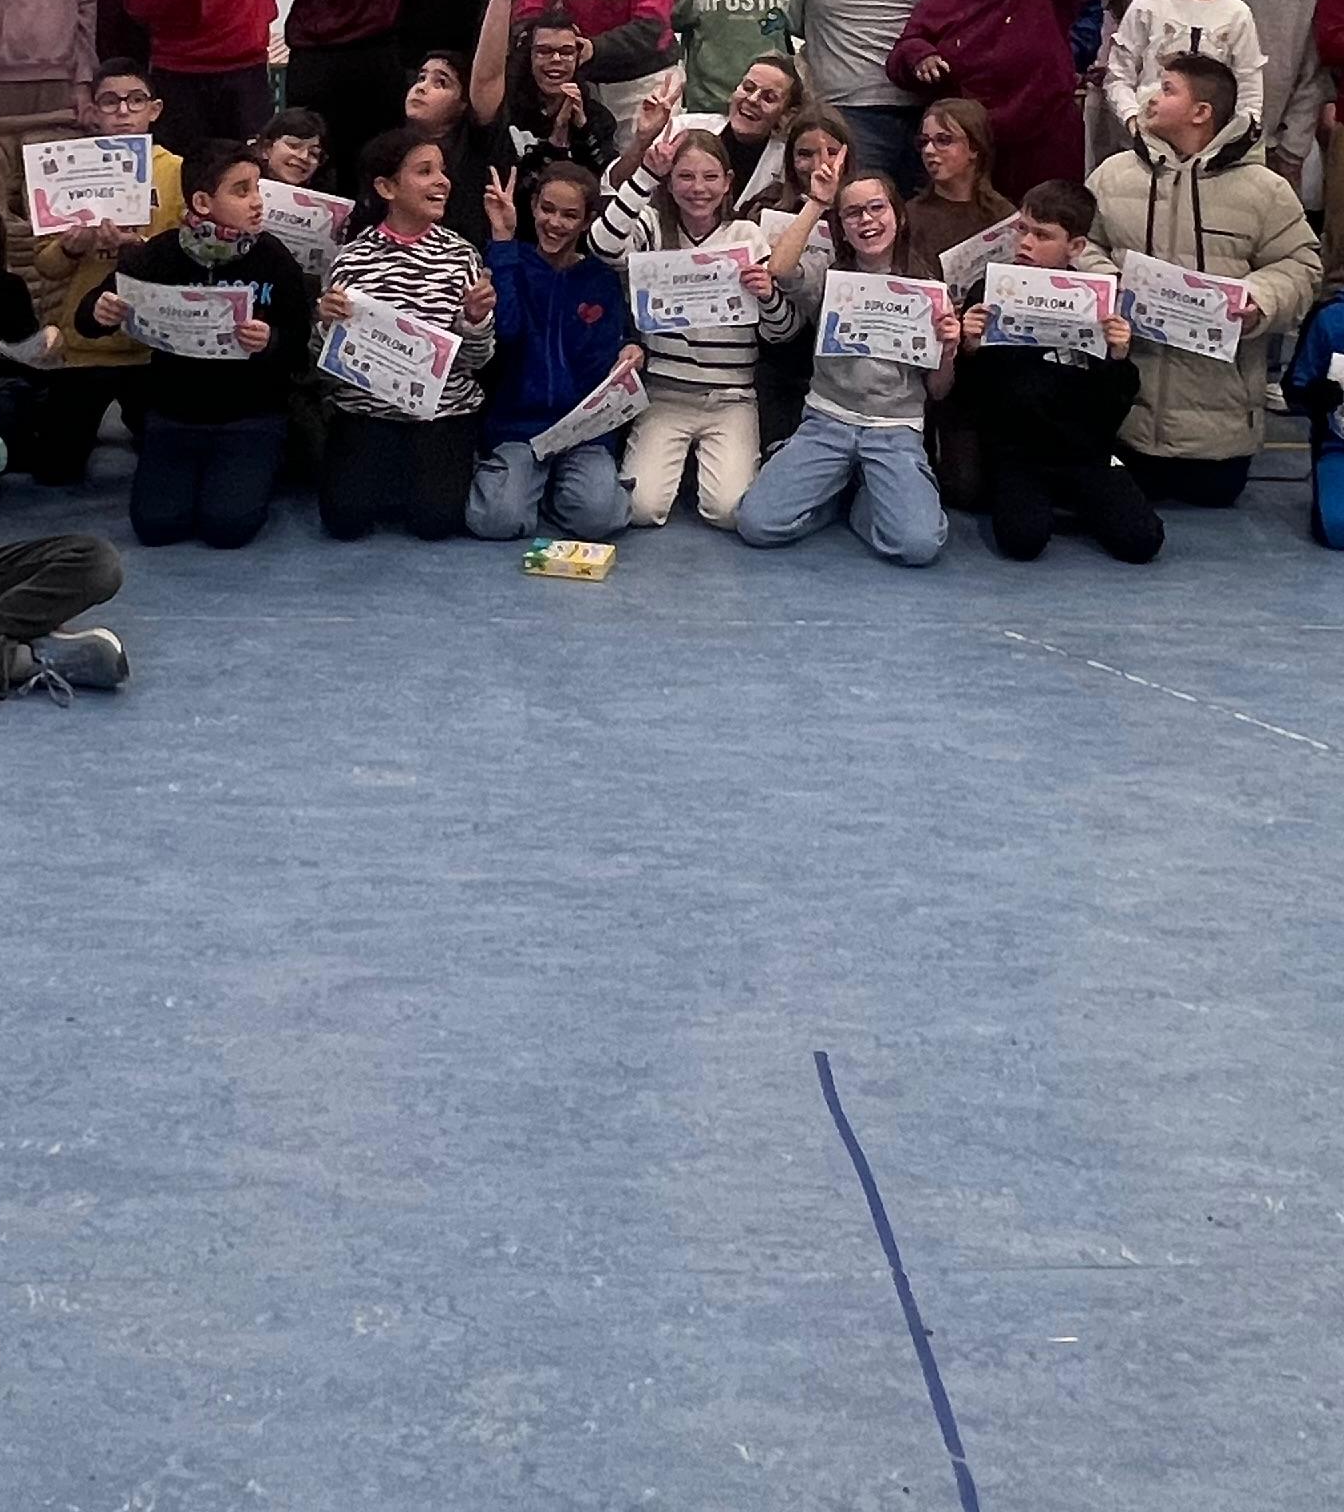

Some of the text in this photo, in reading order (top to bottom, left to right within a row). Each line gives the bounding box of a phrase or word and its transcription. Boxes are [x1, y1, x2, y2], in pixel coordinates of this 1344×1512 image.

[267, 208, 312, 228] DIPLOMA
[672, 271, 718, 285] DIPLOMA
[1026, 295, 1075, 311] DIPLOMA
[1160, 287, 1206, 308] DIPLOMA
[158, 304, 210, 318] DIPLOMA
[864, 299, 910, 315] DIPLOMA
[370, 328, 414, 358] DIPLOMA
